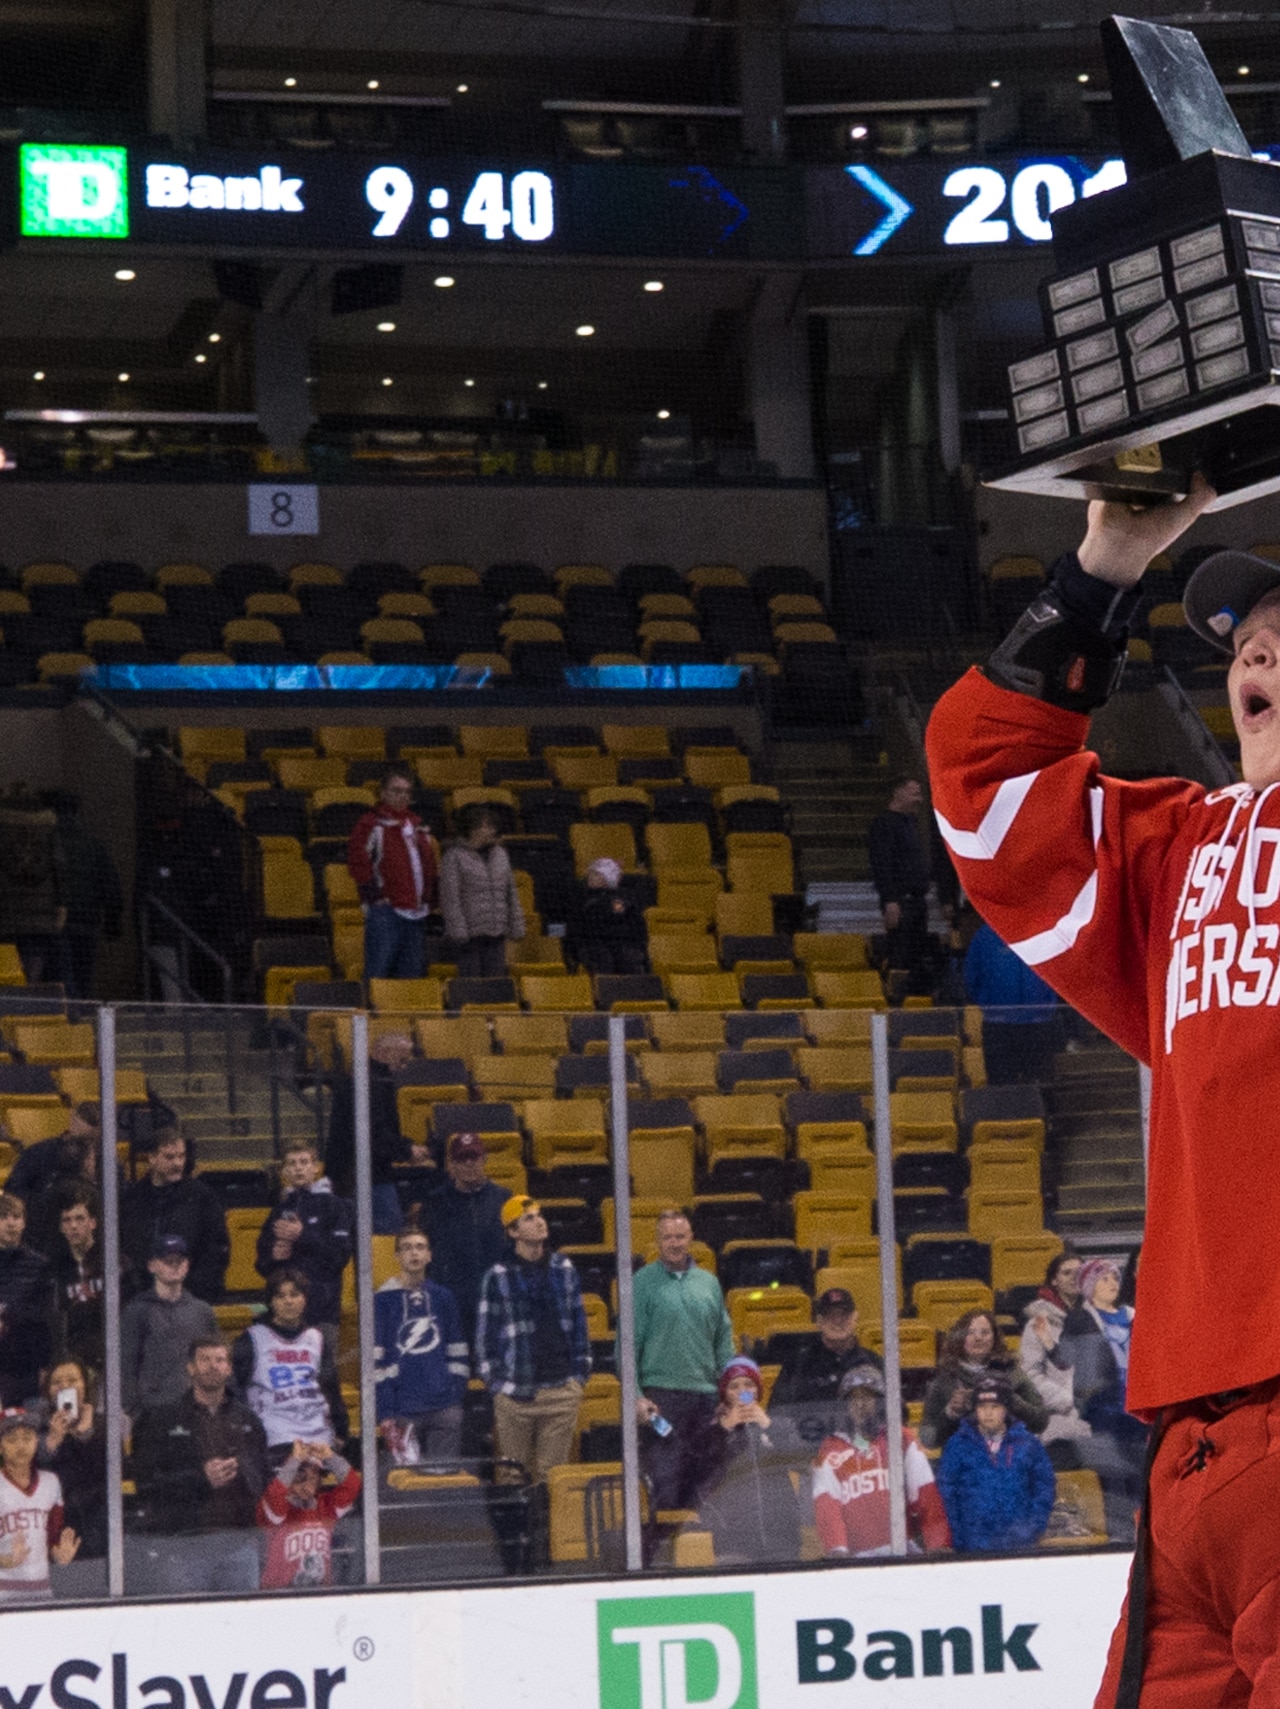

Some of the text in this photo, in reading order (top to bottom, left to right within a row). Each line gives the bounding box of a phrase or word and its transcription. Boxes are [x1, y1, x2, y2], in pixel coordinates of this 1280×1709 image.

[30, 160, 305, 220] TD Bank
[365, 165, 555, 241] 9:40
[270, 491, 294, 528] 8
[611, 1603, 1043, 1709] TD Bank
